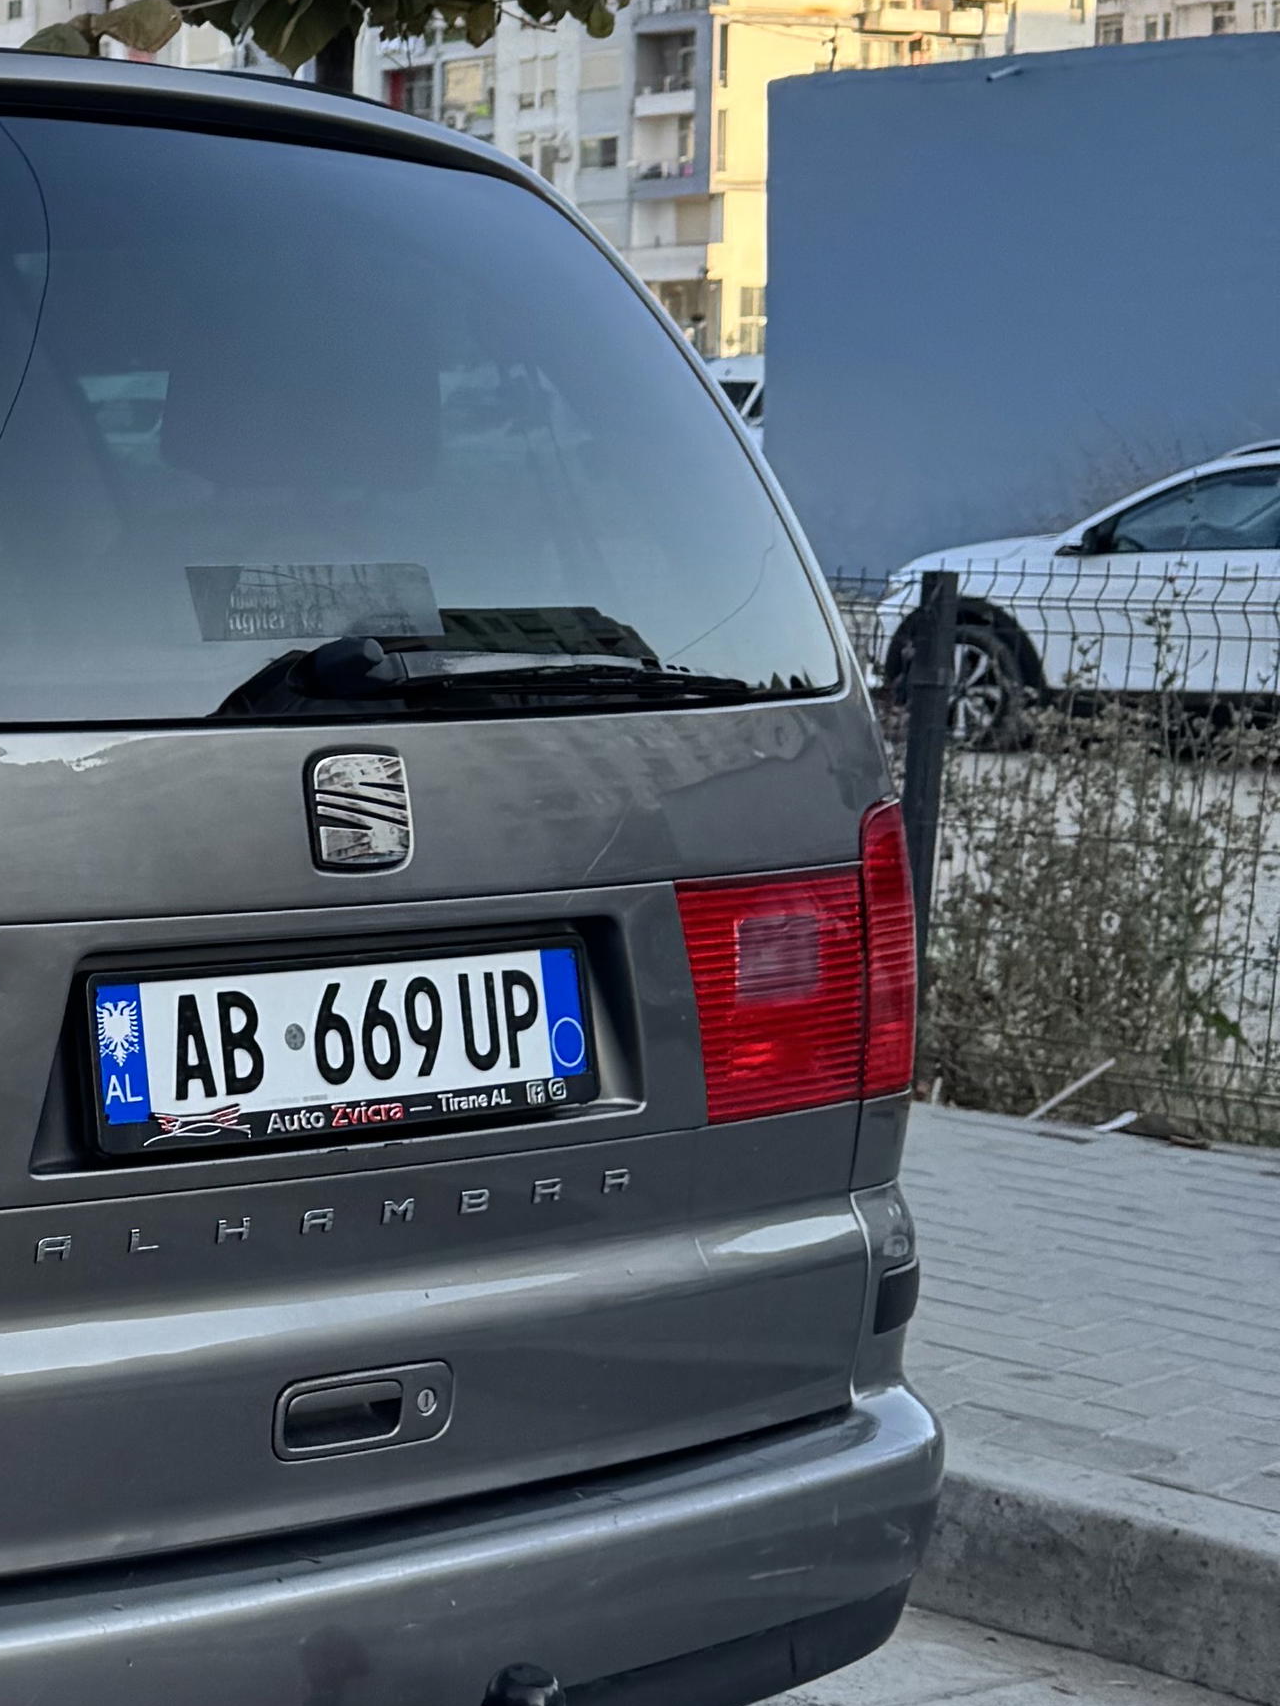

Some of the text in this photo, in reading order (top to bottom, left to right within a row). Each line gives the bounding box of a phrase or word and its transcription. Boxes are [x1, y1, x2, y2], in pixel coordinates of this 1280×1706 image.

[174, 989, 265, 1101] AB
[105, 1072, 143, 1106] AL
[266, 1109, 326, 1135] Auto
[436, 1092, 489, 1113] Tirane
[490, 1087, 513, 1107] AL
[35, 1168, 631, 1263] ALHAMBRA
